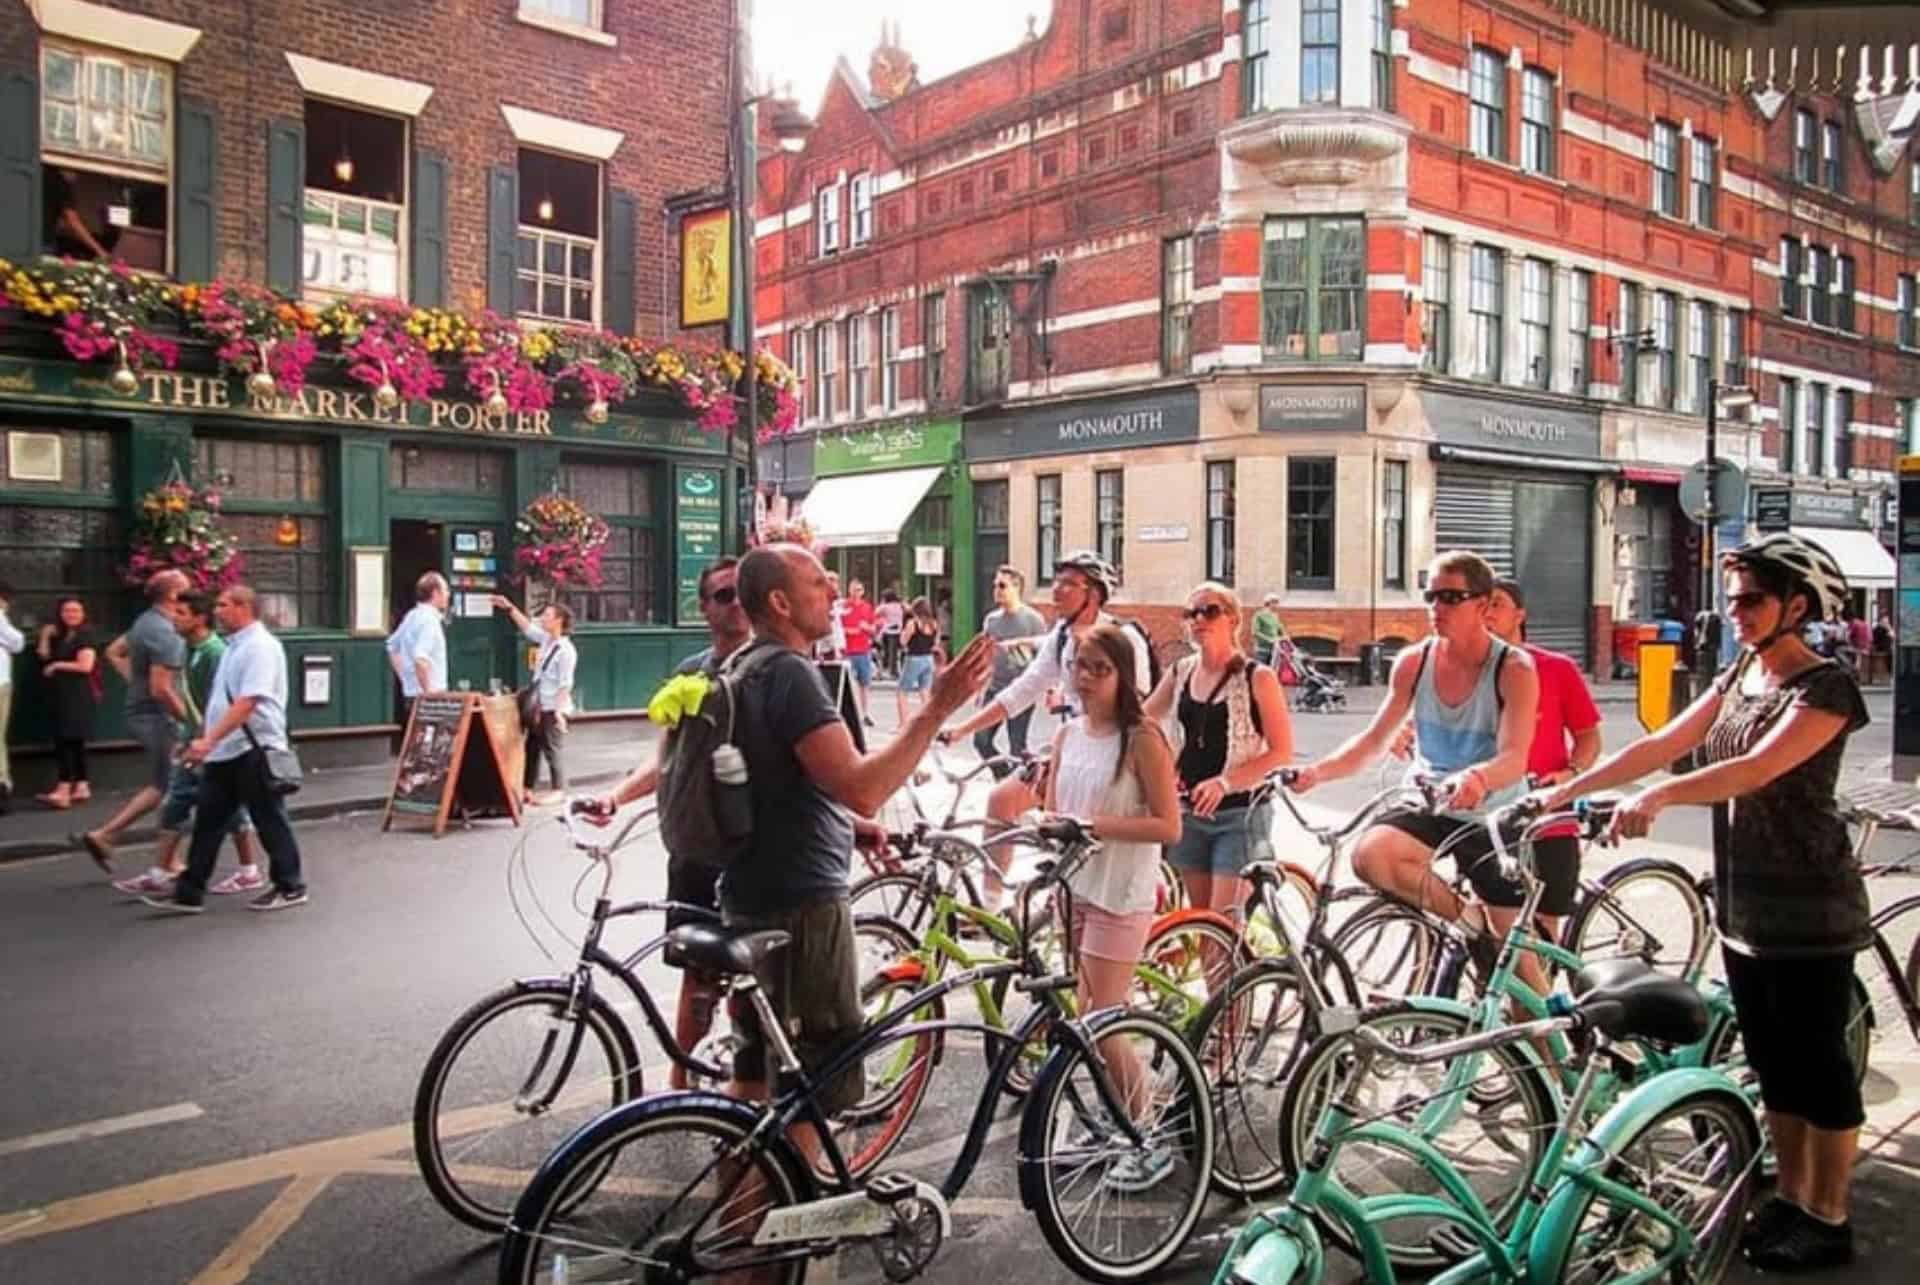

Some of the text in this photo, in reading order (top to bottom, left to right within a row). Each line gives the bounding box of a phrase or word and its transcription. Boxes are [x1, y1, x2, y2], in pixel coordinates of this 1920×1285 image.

[143, 373, 230, 409] THE
[430, 400, 551, 435] PORTER
[1268, 396, 1358, 409] MONMOUTH
[1058, 410, 1163, 440] MONMOUTH
[1480, 416, 1567, 440] MONMOUTH
